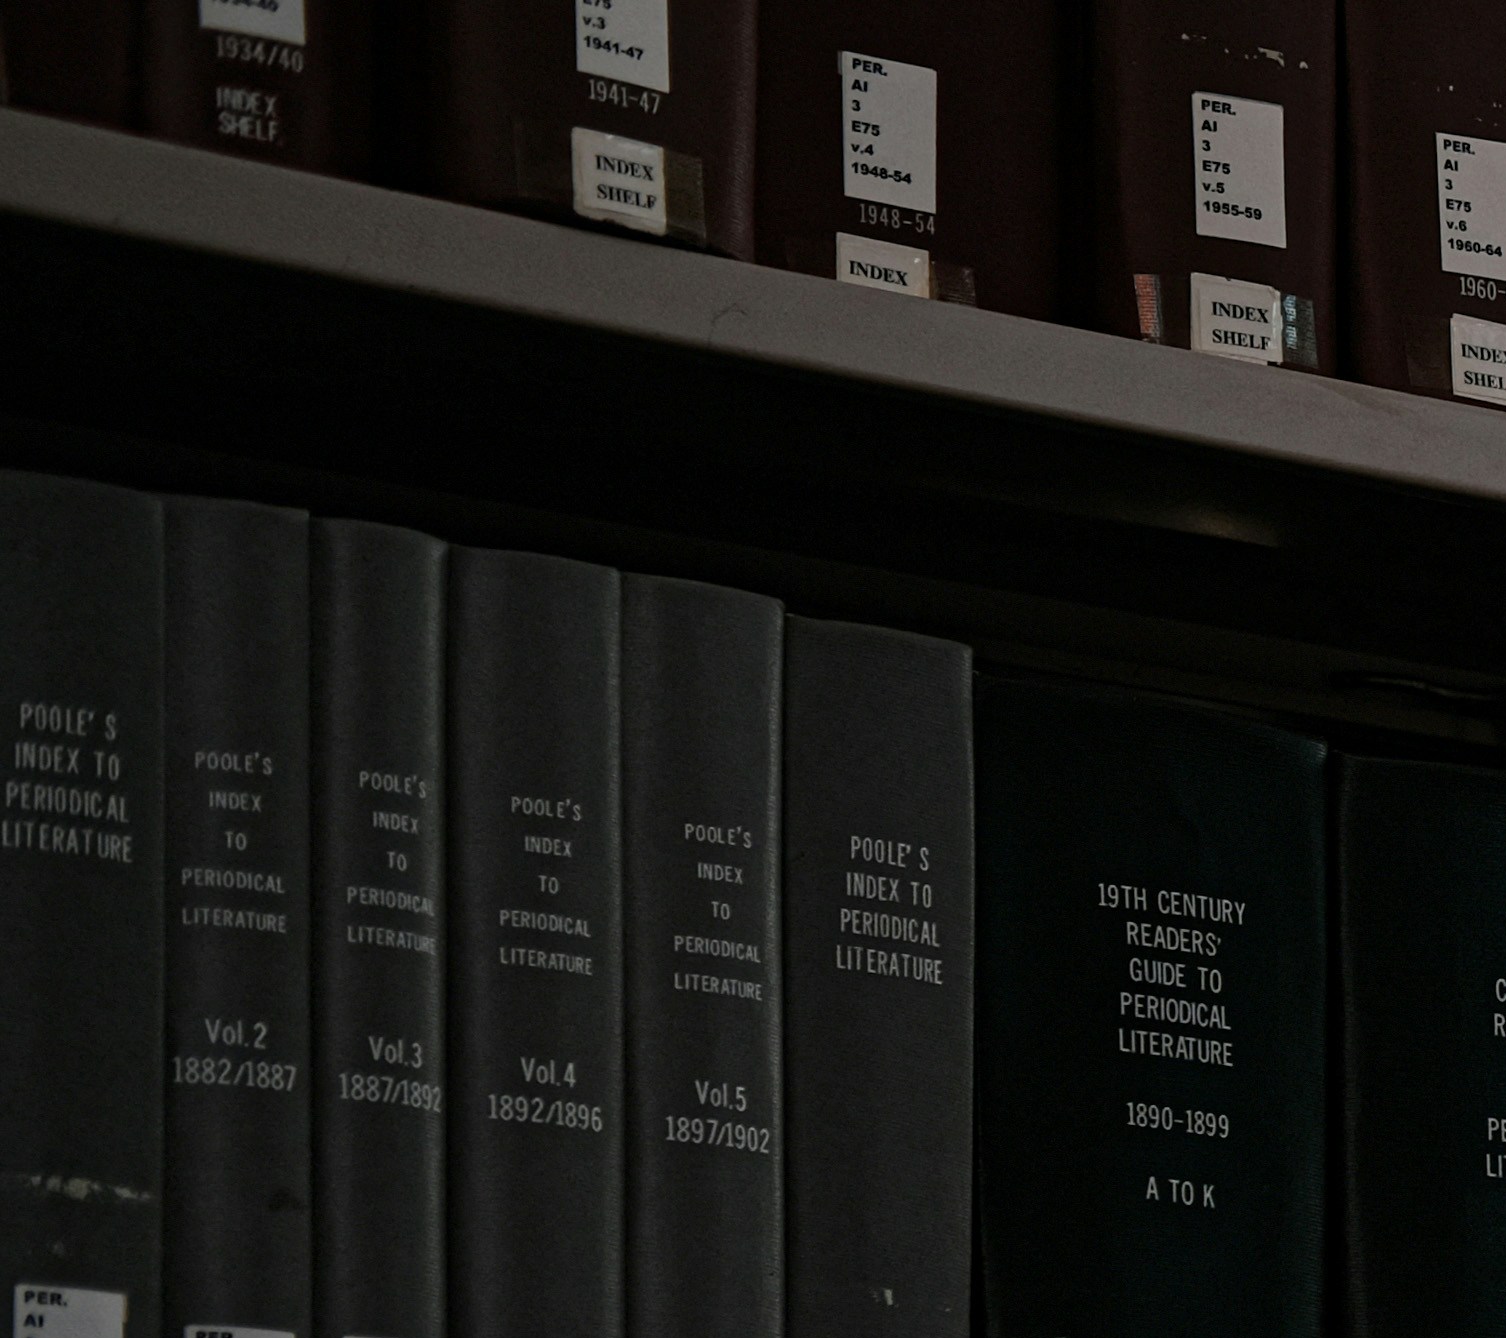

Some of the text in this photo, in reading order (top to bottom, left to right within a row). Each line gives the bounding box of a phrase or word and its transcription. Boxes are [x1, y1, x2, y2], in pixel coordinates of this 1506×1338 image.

[585, 36, 643, 59] 1941-47
[852, 58, 887, 76] PER.
[589, 79, 660, 114] 1941-47
[852, 144, 873, 155] v.4
[596, 155, 653, 181] INDEX
[852, 162, 911, 184] 1948-54
[597, 186, 655, 209] SHELF
[860, 203, 937, 234] 1948-54
[850, 261, 907, 286] INDEX
[195, 752, 273, 775] POOLE'S
[209, 792, 261, 812] INDEX
[511, 796, 582, 821] POOLE'S
[225, 830, 247, 851] TO
[525, 836, 572, 857] INDEX
[182, 868, 285, 894] PERIODICAL
[538, 875, 559, 894] TO
[847, 872, 932, 908] INDEX TO
[1098, 883, 1245, 925] 19TH CENTURY
[182, 908, 286, 934] LITERATURE
[499, 909, 591, 938] PERIODICAL
[839, 908, 941, 949] PERIODICAL
[1126, 921, 1221, 957] READERS'
[499, 947, 592, 975] LITERATURE
[836, 943, 944, 985] LITERATURE
[1129, 957, 1222, 993] GUIDE TO
[1118, 992, 1232, 1031] PERIODICAL
[205, 1019, 267, 1049] Vol.2
[1119, 1024, 1233, 1067] LITERATURE
[173, 1057, 297, 1091] 1882/1887
[521, 1057, 576, 1088] Vol.4
[489, 1094, 602, 1132] 1892/1896
[1127, 1102, 1229, 1138] 1890-1899
[1146, 1176, 1215, 1208] A TO K
